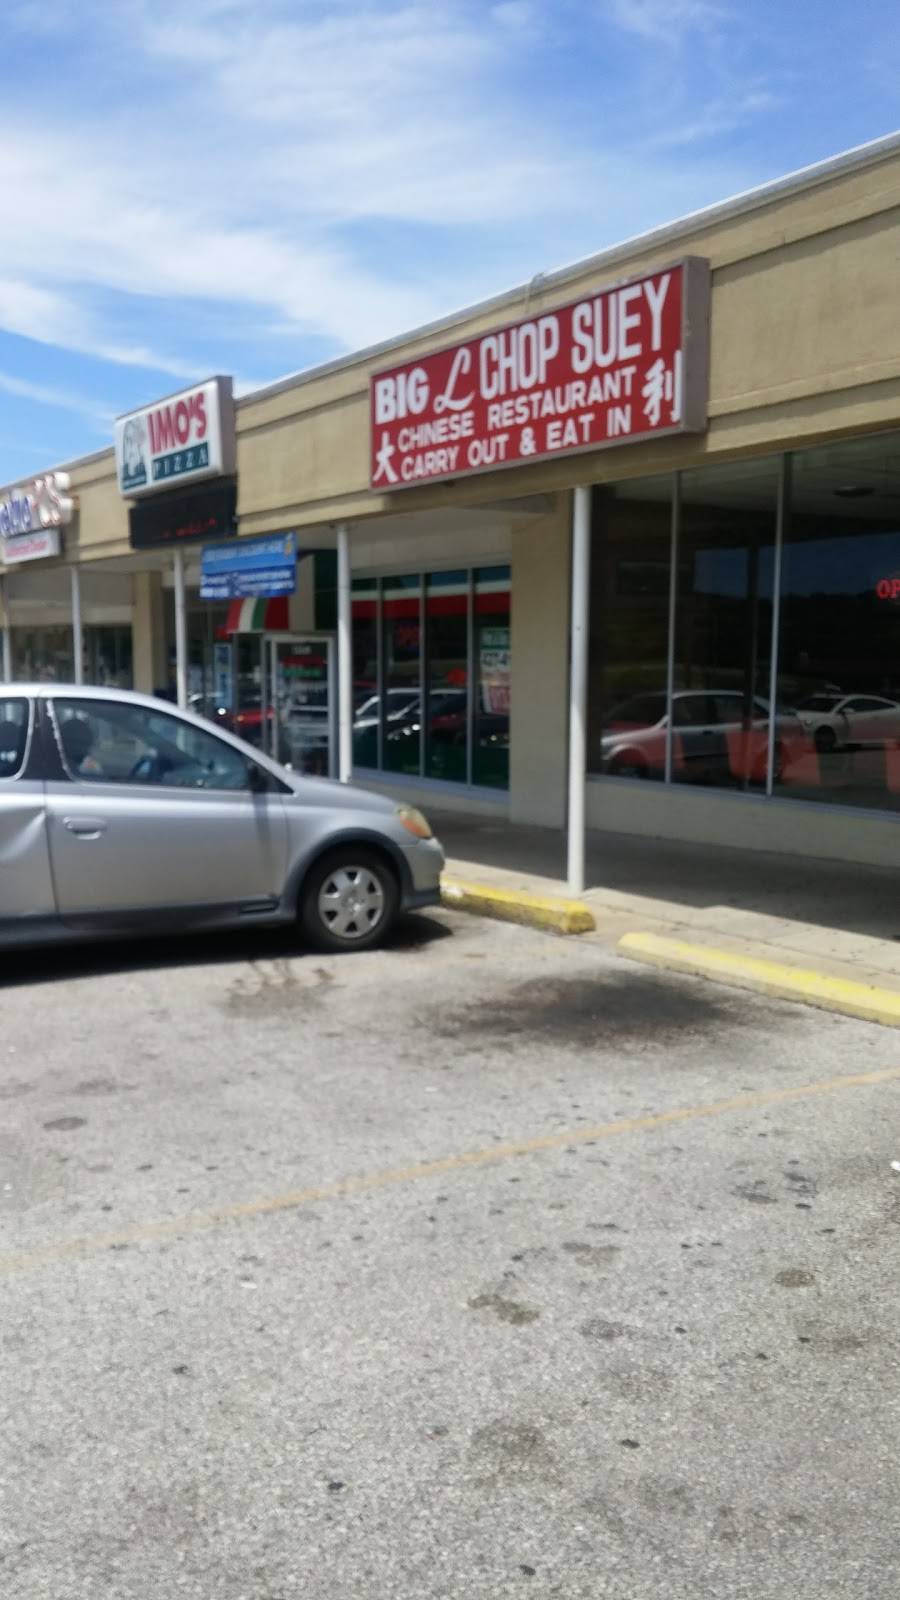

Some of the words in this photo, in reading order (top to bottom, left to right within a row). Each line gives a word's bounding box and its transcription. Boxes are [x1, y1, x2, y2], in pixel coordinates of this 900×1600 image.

[374, 367, 430, 425] BIG
[433, 346, 475, 414] L
[479, 315, 560, 400] CHOP
[570, 273, 671, 374] SUEY
[147, 391, 207, 455] IMO'S
[397, 410, 475, 453] CHINESE
[487, 366, 637, 430] RESTAURANT
[401, 445, 460, 481] CARRY
[467, 431, 509, 467] OUT
[518, 426, 537, 456] &
[546, 413, 595, 450] EAT
[606, 404, 632, 437] IN
[153, 447, 208, 479] PIZZA
[372, 431, 398, 484] 大
